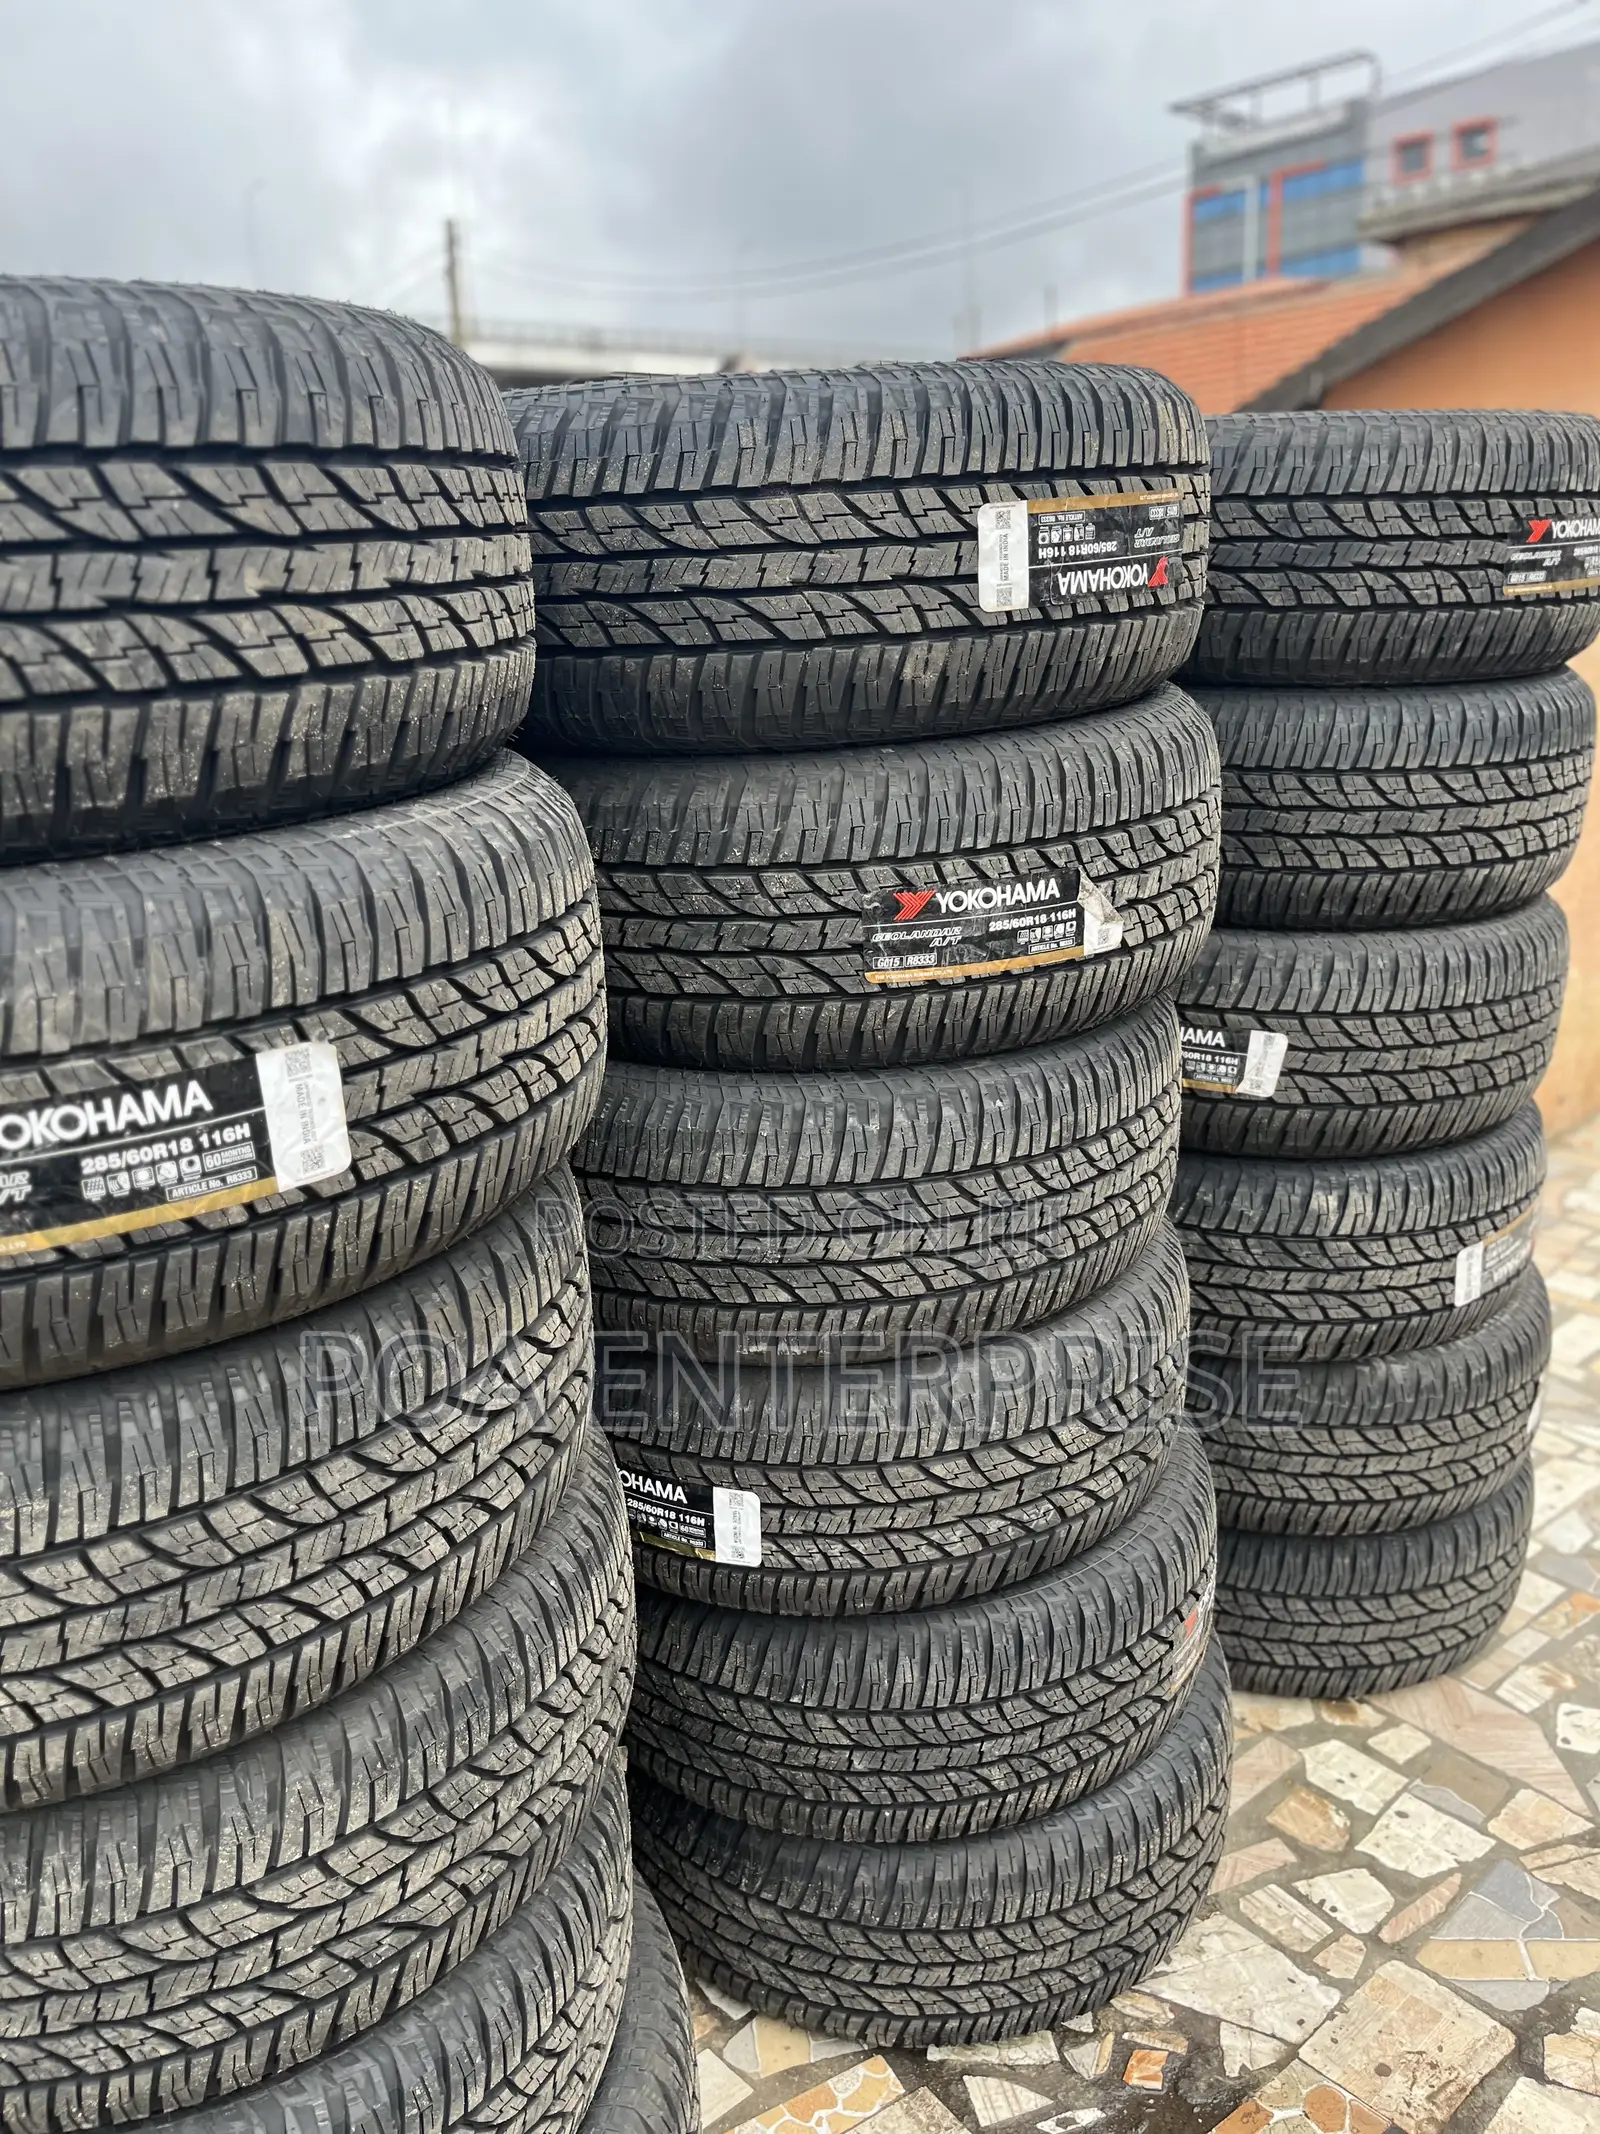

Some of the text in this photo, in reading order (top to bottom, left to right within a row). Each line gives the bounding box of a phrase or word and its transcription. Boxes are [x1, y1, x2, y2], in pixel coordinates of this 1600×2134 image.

[1038, 541, 1118, 559] 285/60R18 116H
[1057, 562, 1149, 596] YOKOHAMA
[935, 877, 1060, 914] YOKOHAMA
[989, 908, 1077, 932] 285/60R18 116H
[872, 926, 962, 943] GEOLANDAR
[929, 935, 963, 947] A/T
[877, 957, 901, 968] G015
[907, 954, 935, 966] R8333
[1214, 1055, 1239, 1065] 116H
[295, 1083, 312, 1145] MADE IN INDIA
[81, 1122, 252, 1175] 285/60R18 116H
[206, 1145, 252, 1169] 60 MONTHS
[172, 1170, 253, 1198] ARTICLE No. R8333
[626, 1498, 706, 1527] 285/60R18 116H
